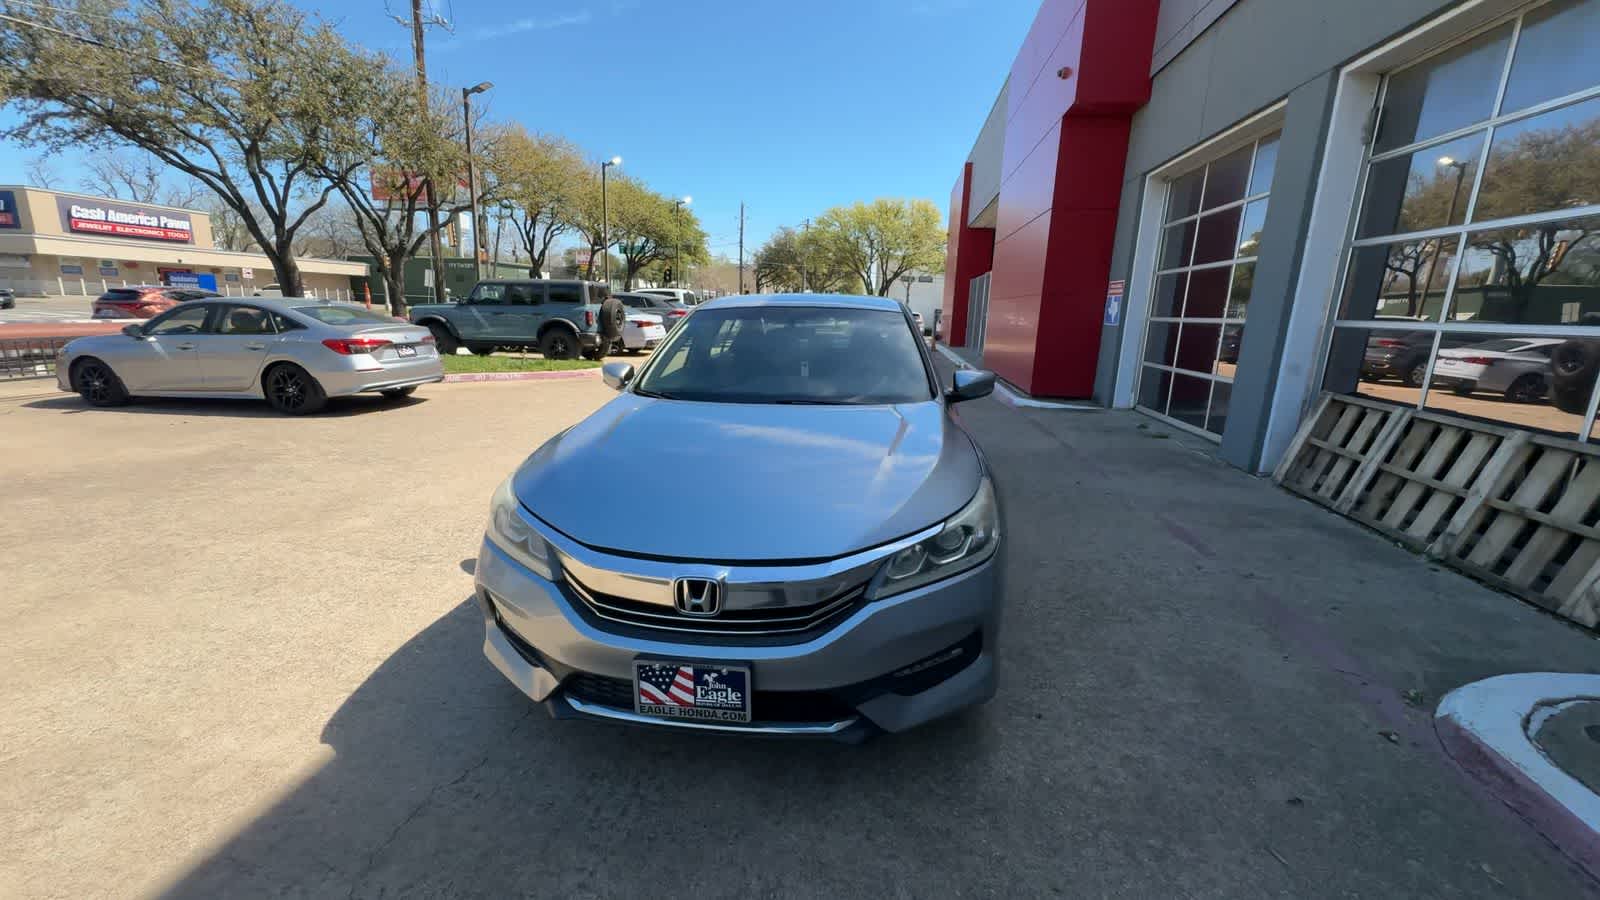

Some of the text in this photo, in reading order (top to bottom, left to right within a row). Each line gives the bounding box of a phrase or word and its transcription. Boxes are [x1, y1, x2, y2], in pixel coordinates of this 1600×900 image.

[70, 205, 190, 230] Cash America Pawn
[77, 222, 189, 239] JEWELRY ELECTRONICS TOOLS
[696, 685, 742, 703] Eagle
[708, 681, 727, 690] John
[639, 705, 676, 715] EAGLE
